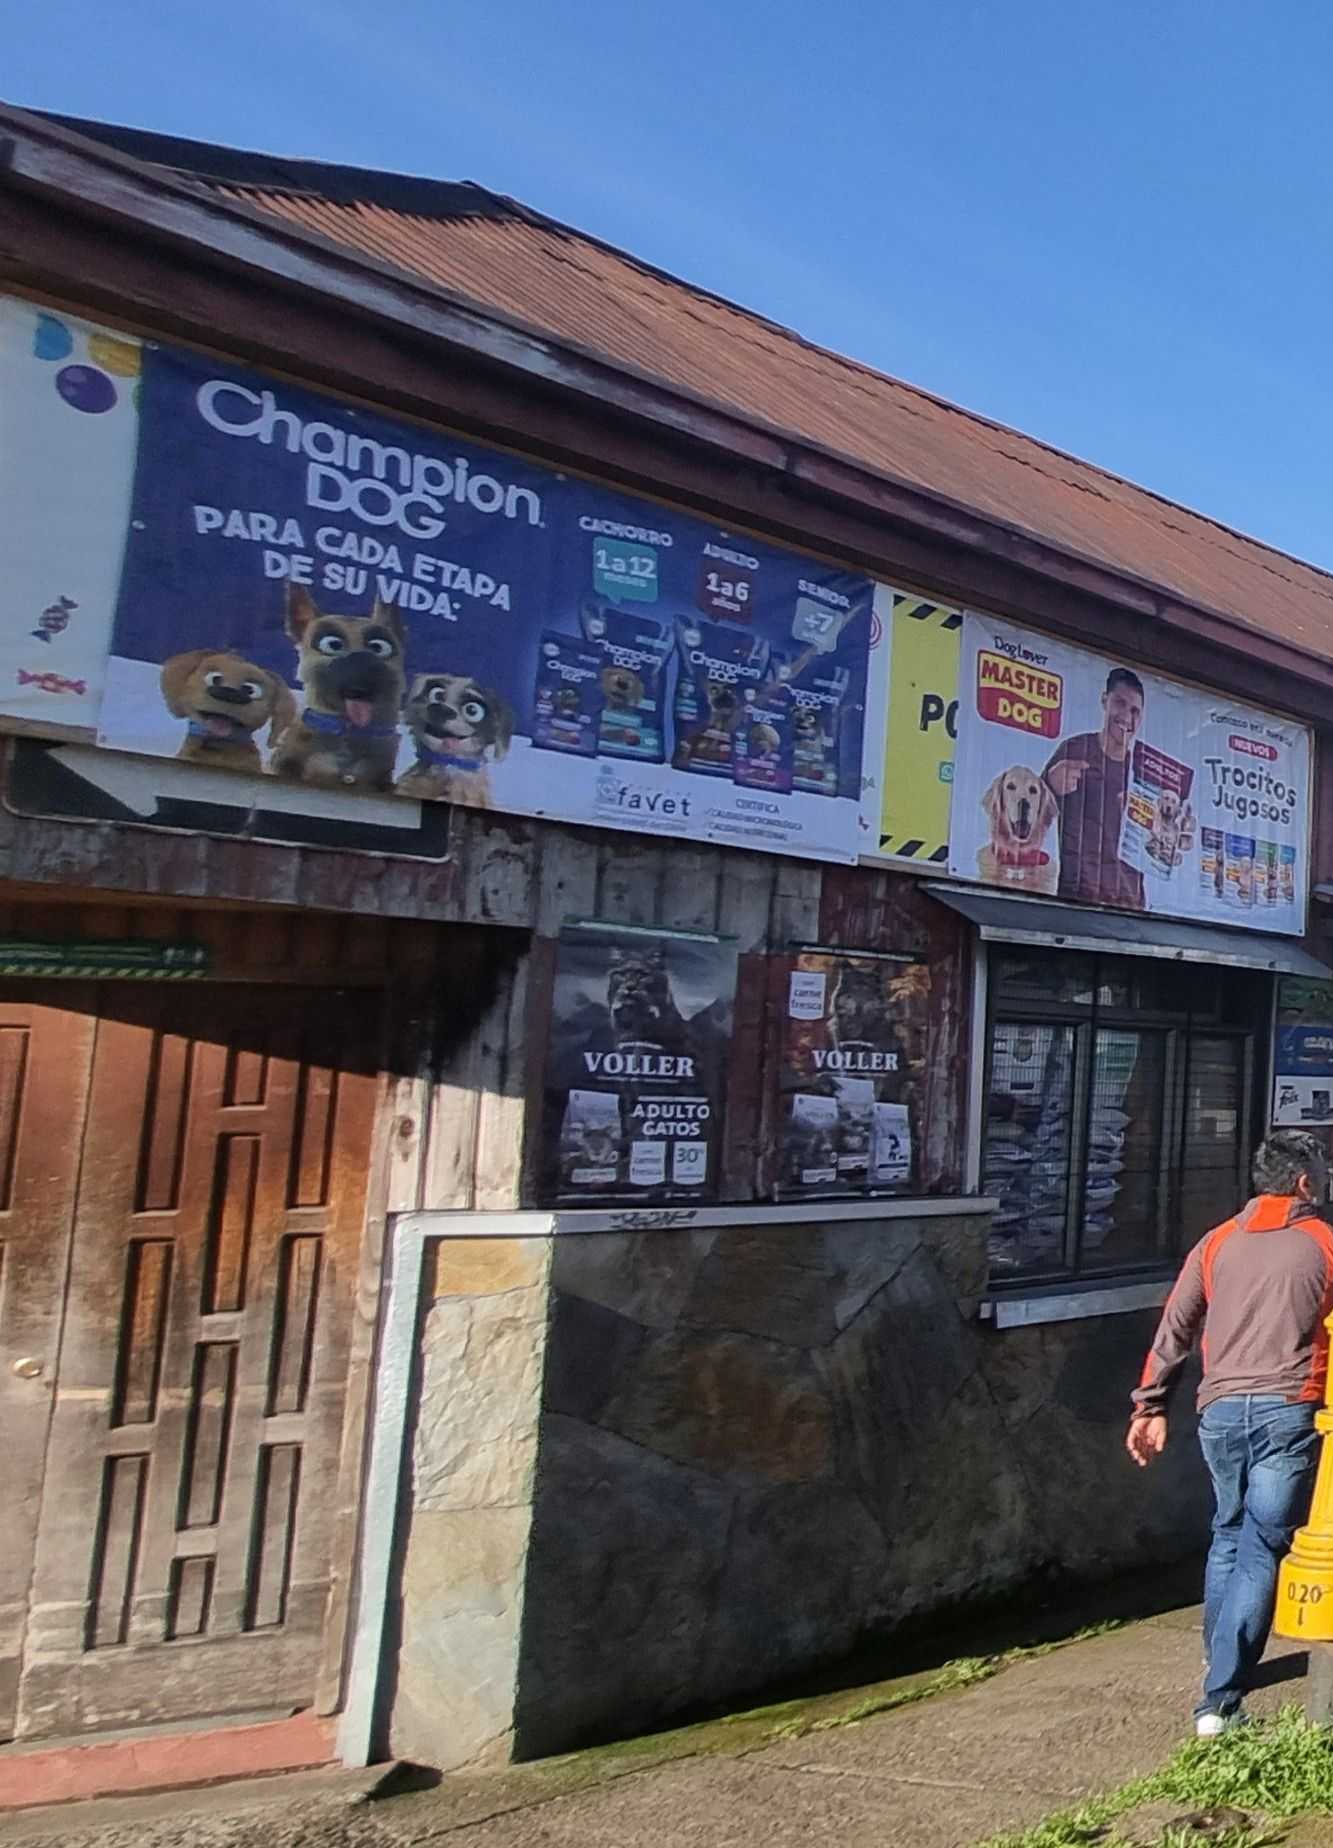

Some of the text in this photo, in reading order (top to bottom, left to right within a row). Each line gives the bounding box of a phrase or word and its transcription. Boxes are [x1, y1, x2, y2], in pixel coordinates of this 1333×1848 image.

[197, 380, 540, 526] Champion
[306, 463, 446, 539] DOG
[578, 516, 674, 547] CACHORRO
[194, 505, 511, 611] PARA CADA ETAPA
[704, 542, 759, 571] ADULTO
[263, 549, 460, 622] DE SU VIDA:
[690, 650, 760, 680] Champion
[708, 668, 738, 684] DOG
[982, 659, 1059, 702] MASTER
[997, 697, 1042, 728] DOG
[1204, 758, 1297, 807] Trocitos
[1212, 785, 1291, 825] Jugosos
[584, 1052, 696, 1077] VOLLER
[812, 1050, 899, 1071] VOLLER
[632, 1104, 711, 1120] ADULTO
[642, 1121, 701, 1137] GATOS
